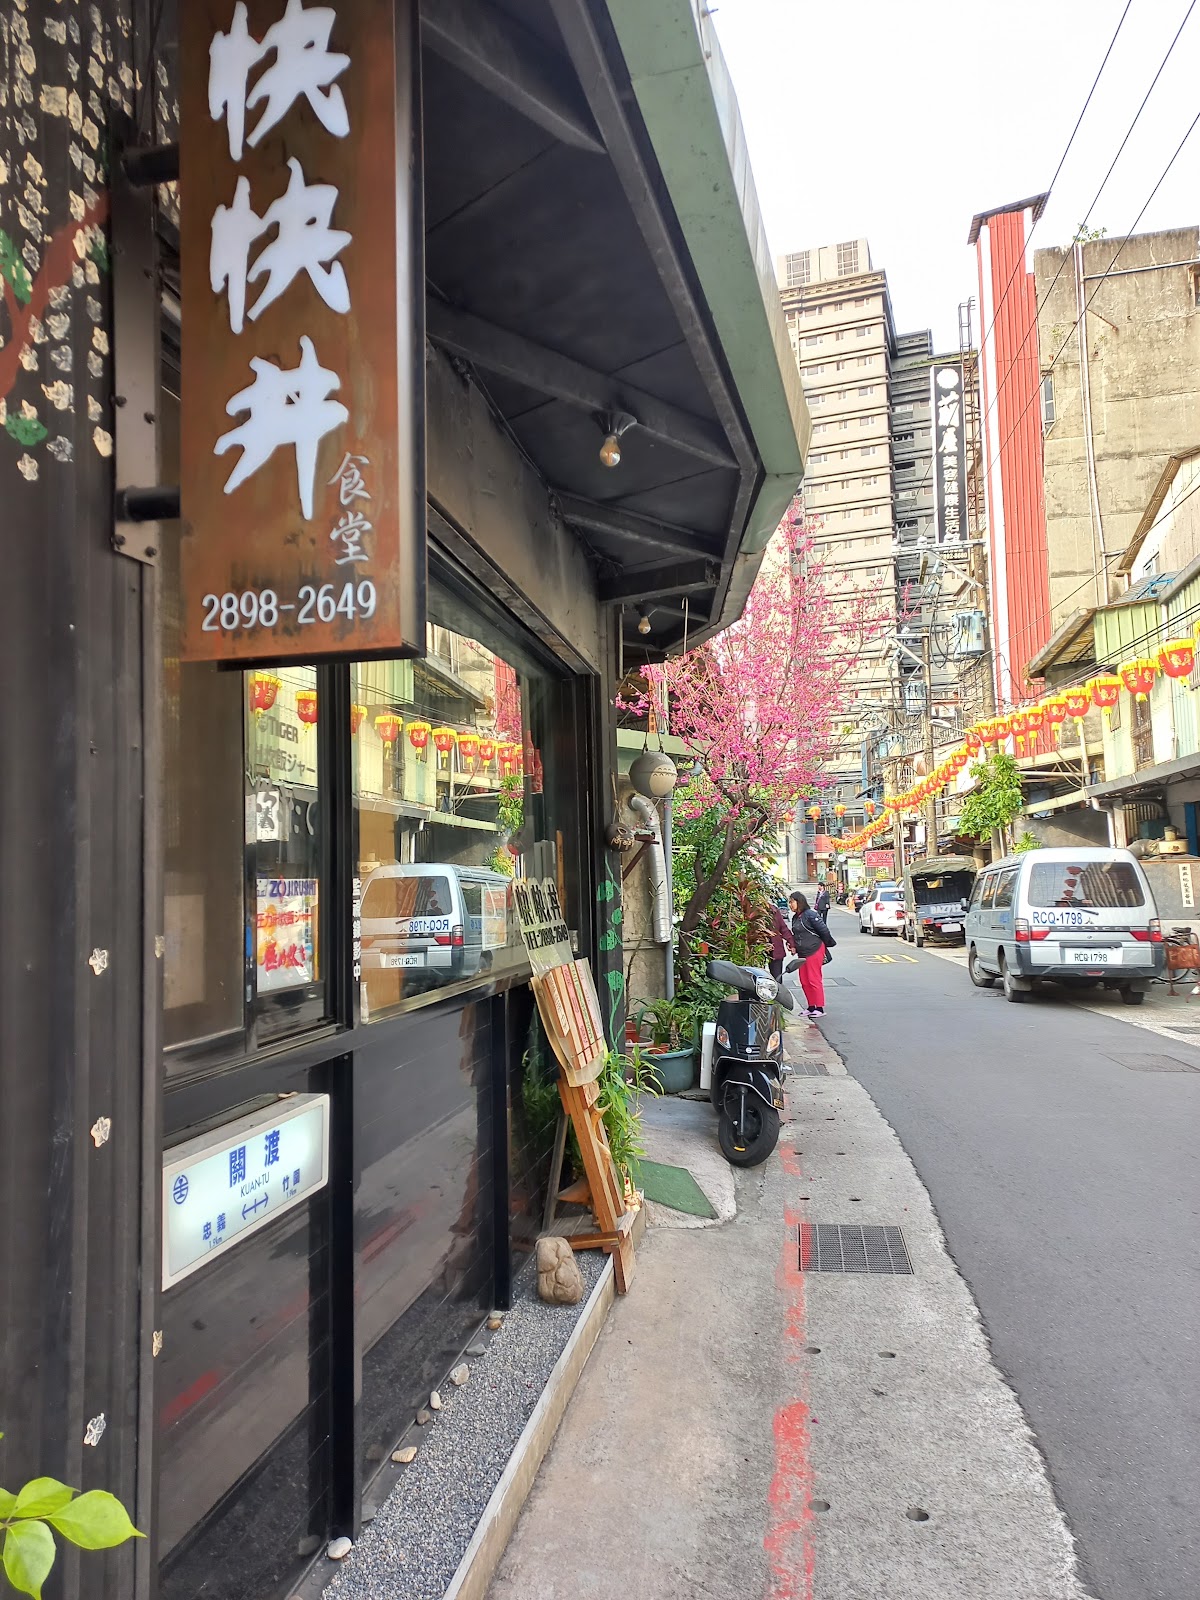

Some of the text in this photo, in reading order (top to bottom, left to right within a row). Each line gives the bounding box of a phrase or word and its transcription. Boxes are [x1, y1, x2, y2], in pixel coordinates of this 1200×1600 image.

[207, 0, 352, 520] 快快丼
[329, 451, 372, 567] 食堂
[201, 580, 378, 634] 2898-2649
[267, 715, 299, 744] TIGER
[269, 880, 316, 897] ZOJIRUSHI
[515, 884, 563, 927] 快快丼
[1032, 911, 1083, 925] RCQ-1798
[857, 953, 920, 964] 30
[1074, 953, 1108, 962] RCQ-1798
[229, 1129, 280, 1188] 關渡
[240, 1171, 270, 1198] KUAN-TU
[203, 1212, 226, 1241] 忠義
